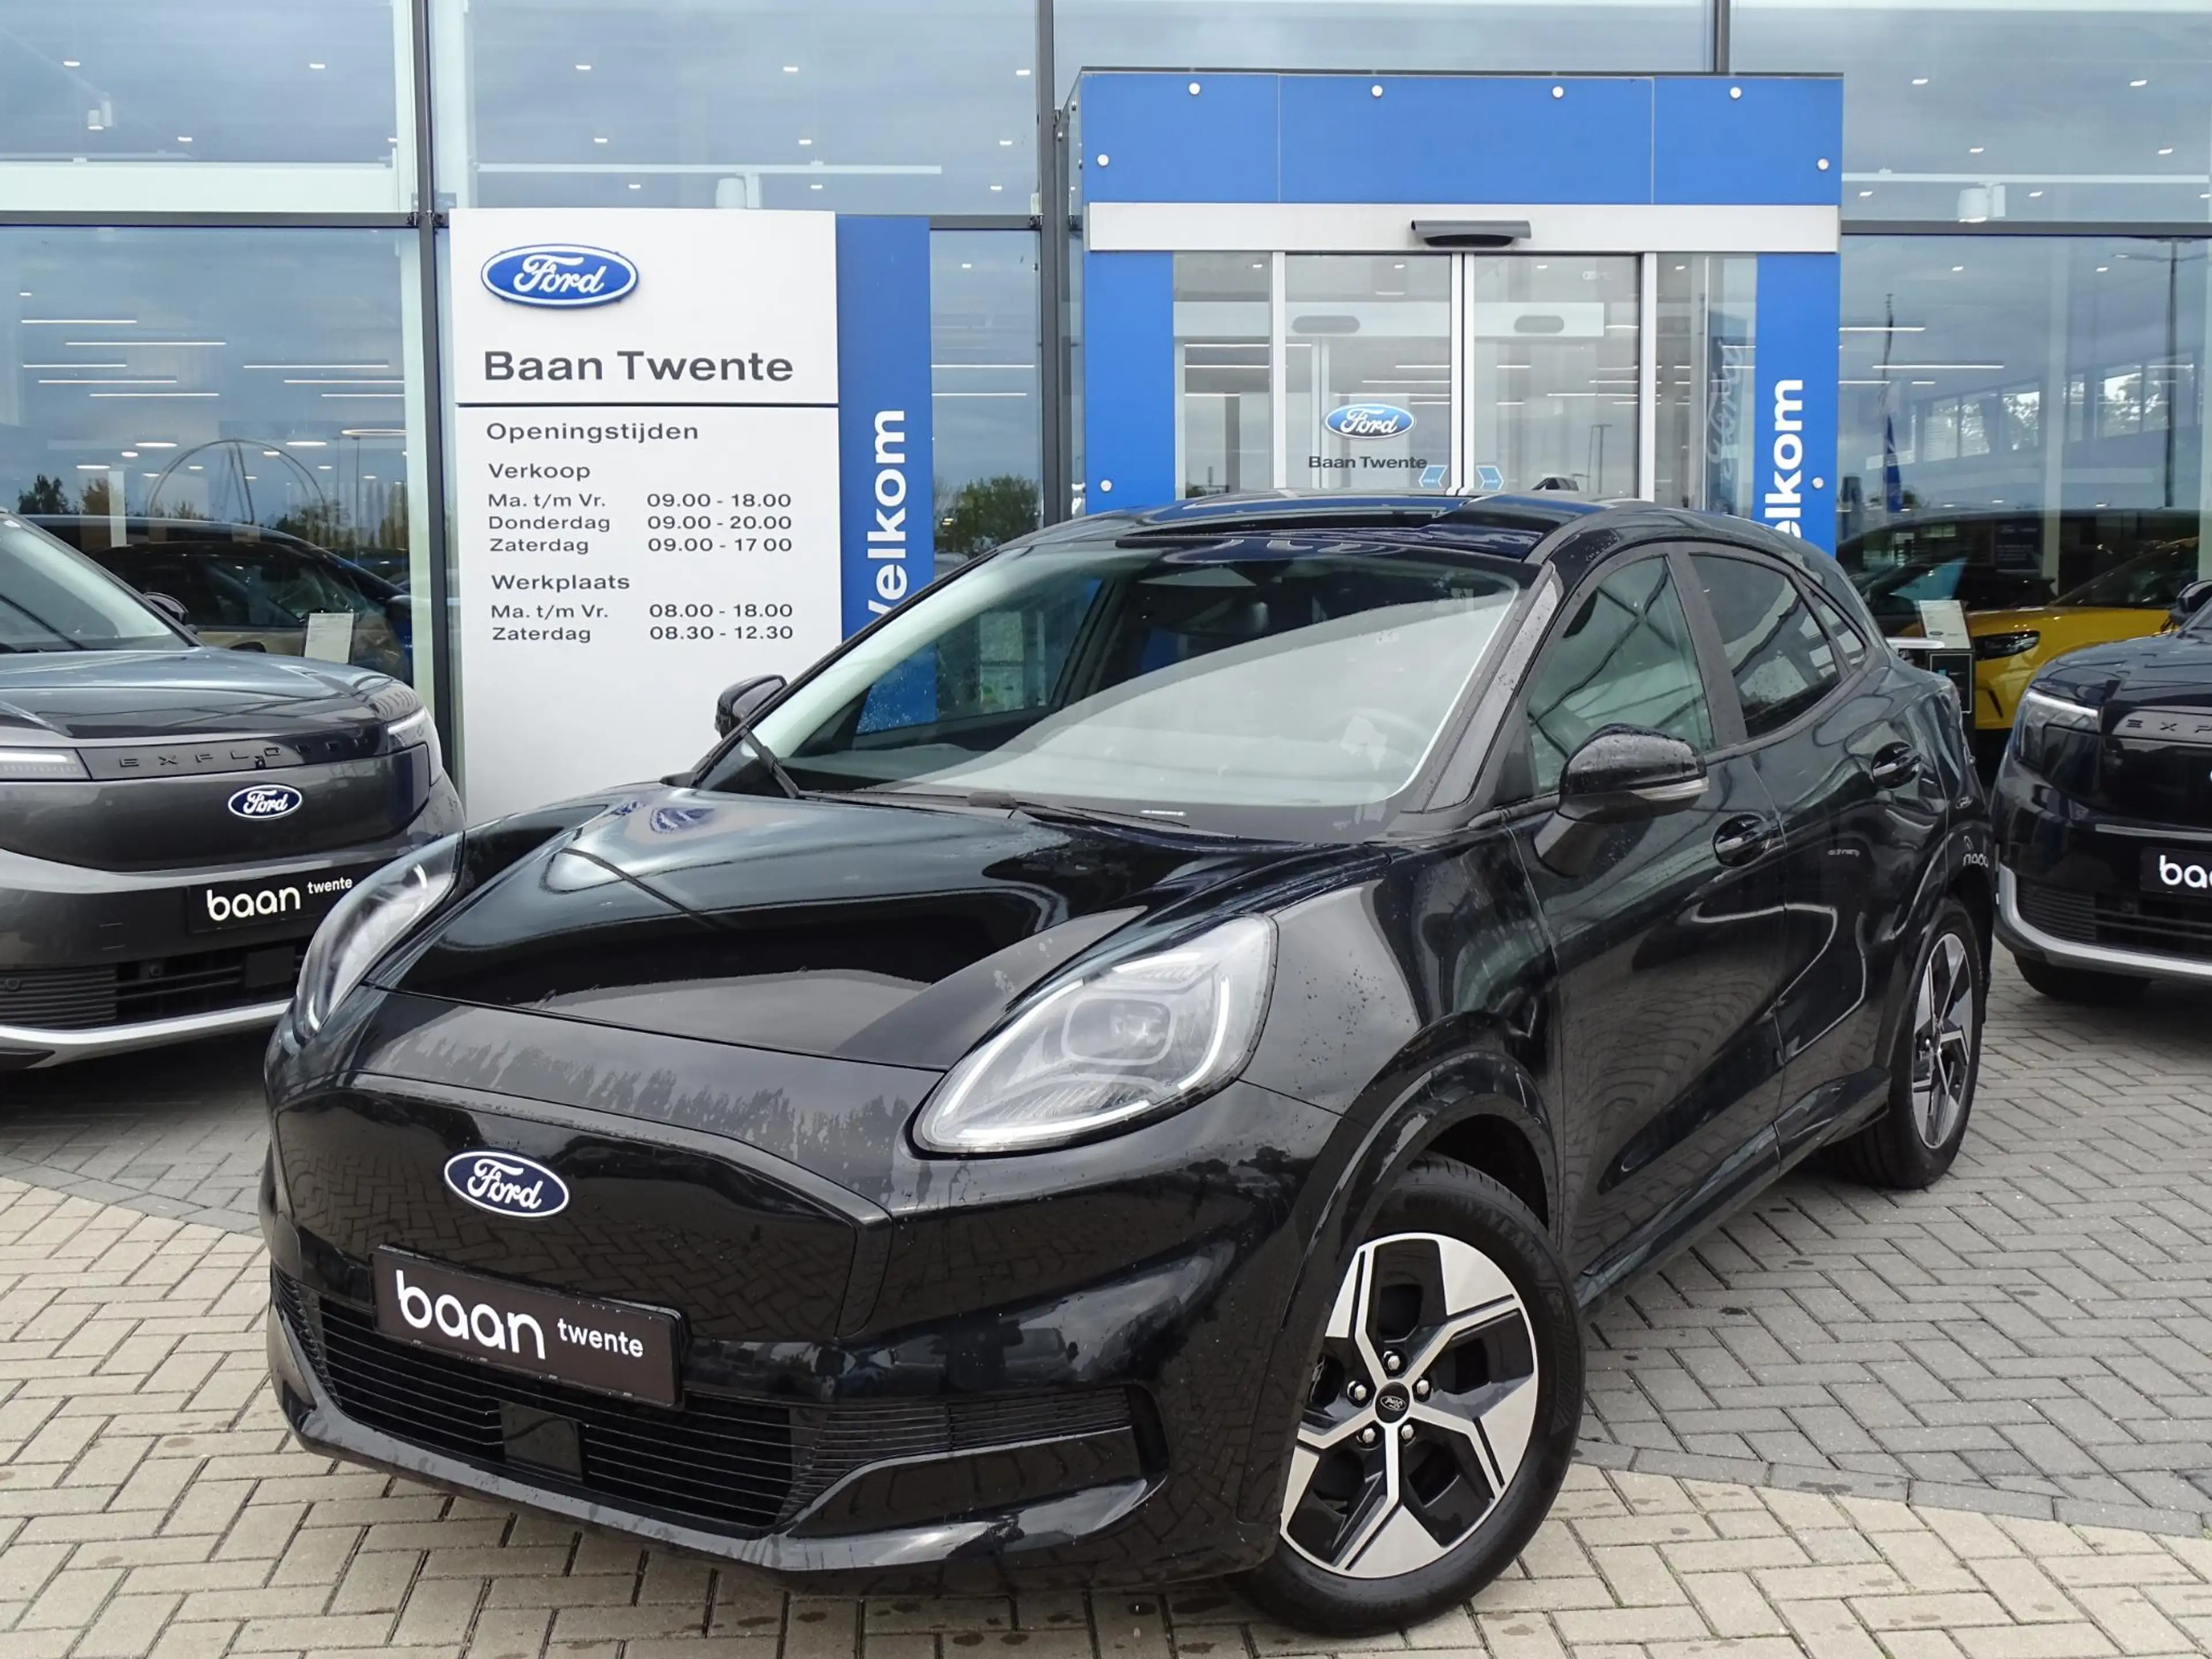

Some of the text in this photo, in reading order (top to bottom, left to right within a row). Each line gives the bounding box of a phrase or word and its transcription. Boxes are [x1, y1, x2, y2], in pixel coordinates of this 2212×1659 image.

[513, 254, 605, 294] Ford
[485, 351, 793, 381] Baan Twente
[486, 422, 698, 444] Openingstijden
[488, 463, 591, 482] Verkoop
[1309, 456, 1427, 469] Baan Twente
[488, 493, 527, 508] Ma.
[534, 494, 572, 509] t/m
[579, 493, 605, 507] Vr.
[647, 493, 711, 507] 09.00
[731, 493, 792, 508] 18.00
[867, 410, 907, 615] elkom
[489, 516, 610, 533] Donderdag
[647, 516, 711, 530] 09.00
[730, 516, 792, 530] 20.00
[490, 537, 589, 555] Zaterdag
[648, 537, 713, 552] 09.00
[491, 574, 630, 594] Werkplaats
[491, 604, 530, 619] Ma.
[537, 604, 575, 620] t/m
[581, 604, 608, 618] Vr.
[649, 603, 714, 618] 08.00
[733, 603, 793, 618] 18.00
[492, 627, 591, 644] Zaterdag
[650, 626, 714, 641] 08.30
[734, 625, 793, 640] 12.30
[243, 789, 289, 814] Ford
[2160, 855, 2212, 888] ba
[206, 876, 353, 921] baan twente
[467, 1158, 544, 1210] Ford
[396, 1270, 644, 1360] baan twente
